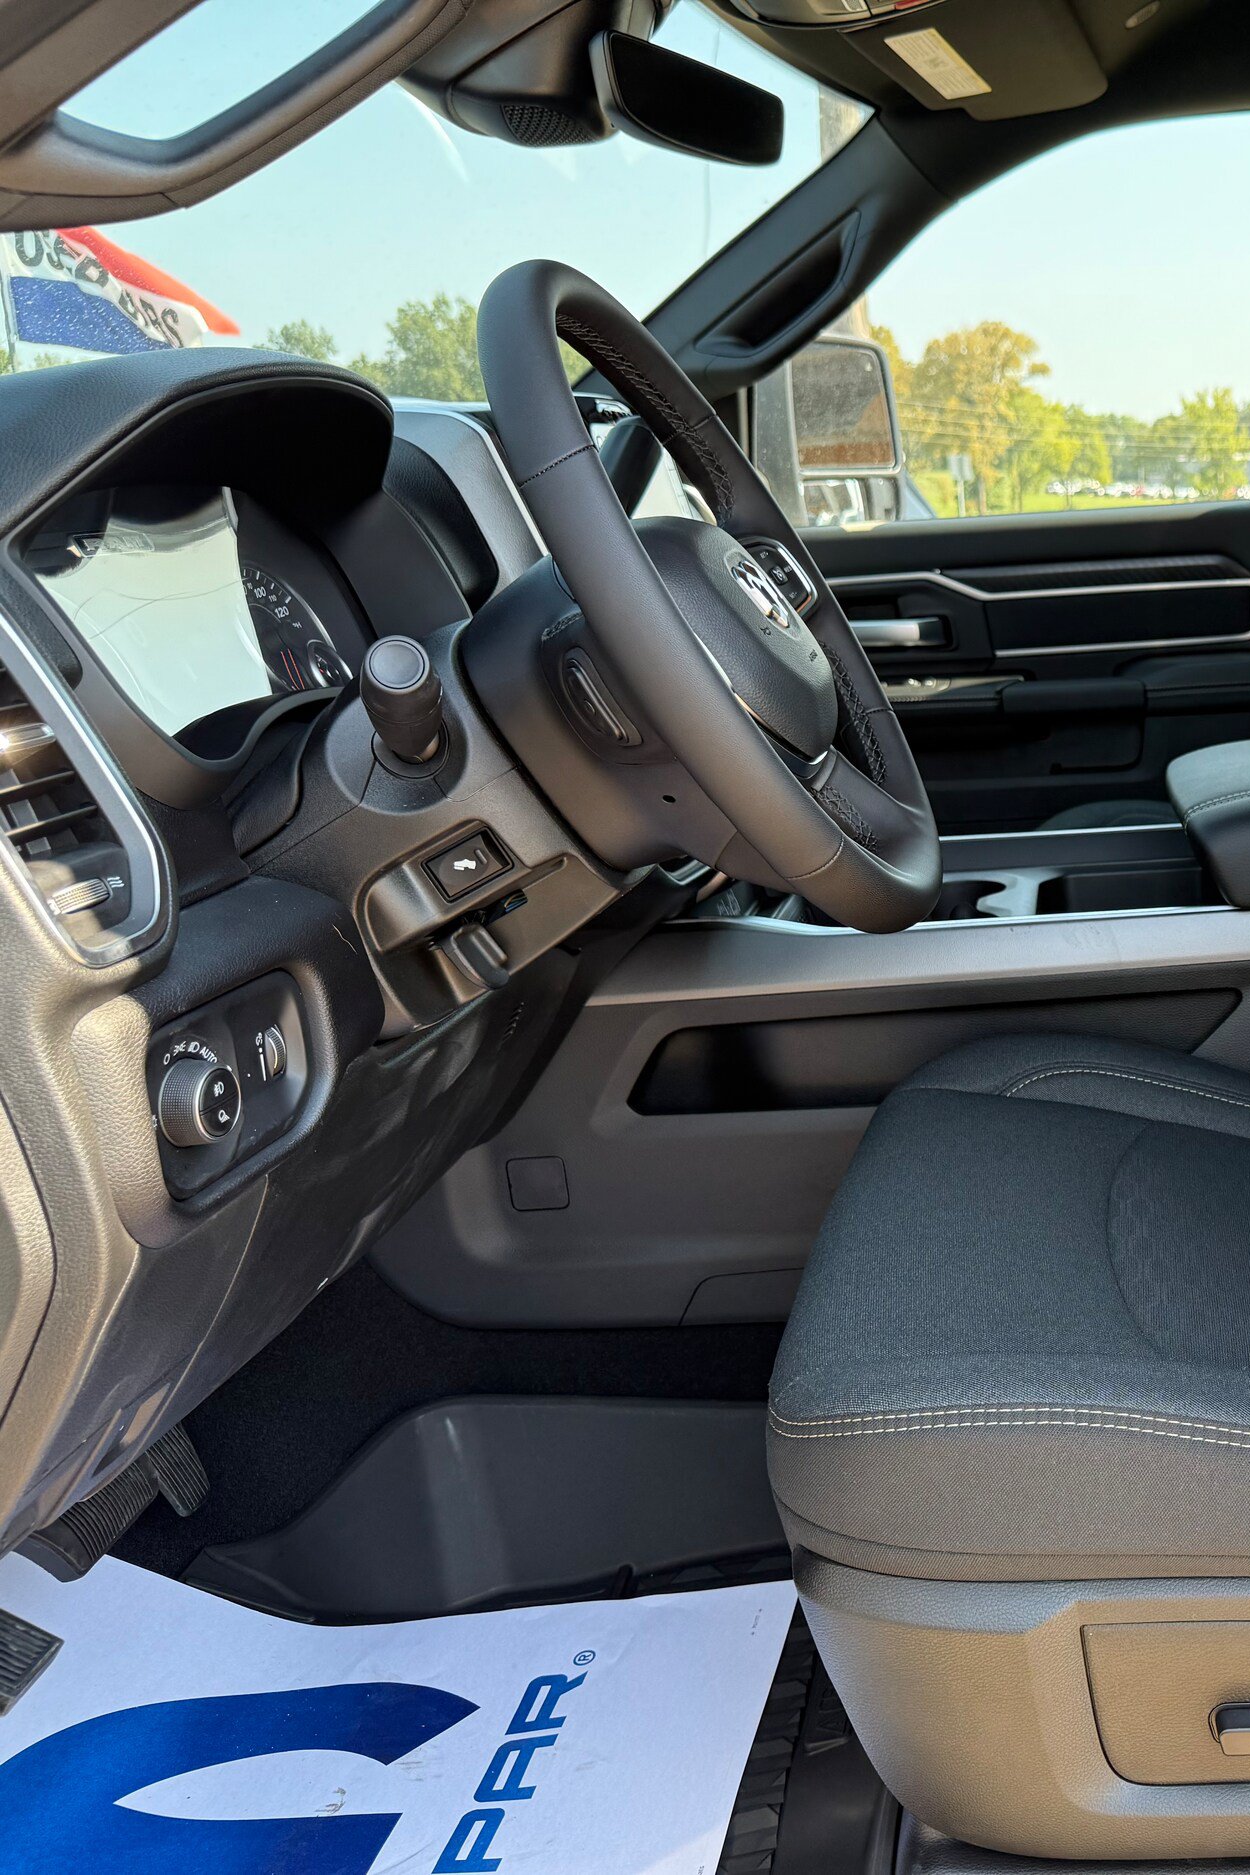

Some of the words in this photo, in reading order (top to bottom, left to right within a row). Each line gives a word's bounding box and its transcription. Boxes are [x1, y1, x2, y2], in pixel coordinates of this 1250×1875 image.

[254, 586, 267, 598] 100
[274, 606, 290, 619] 120
[199, 1046, 218, 1063] AUTO
